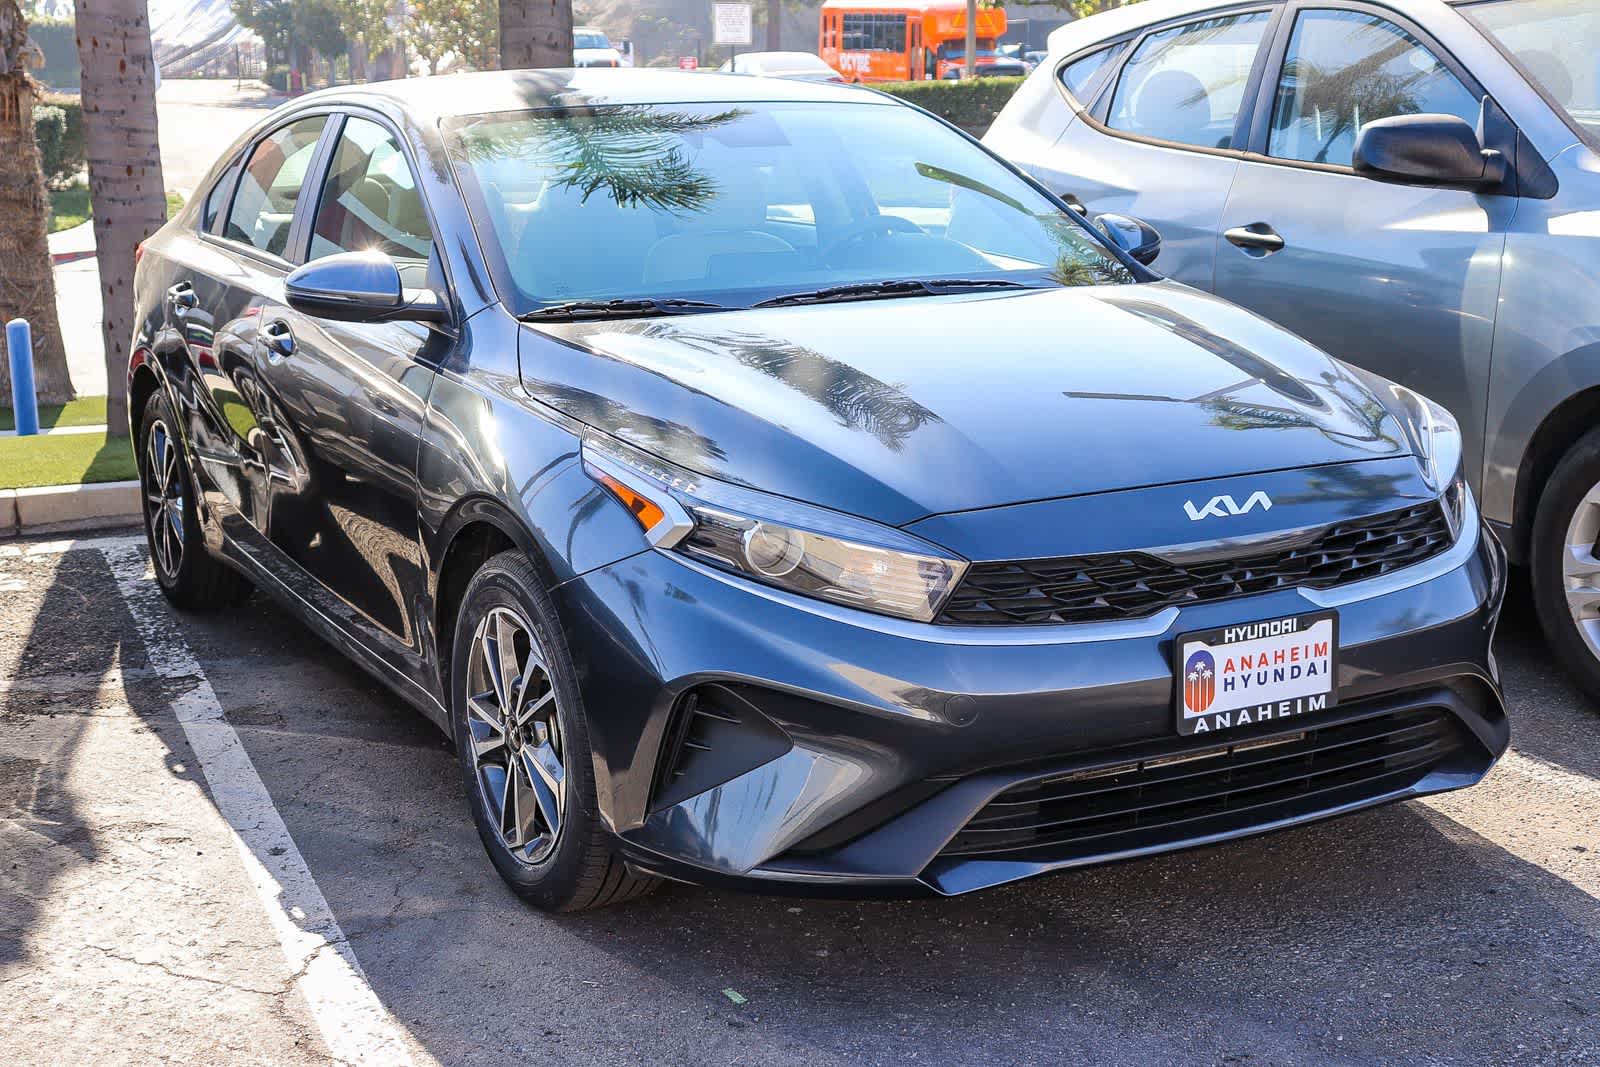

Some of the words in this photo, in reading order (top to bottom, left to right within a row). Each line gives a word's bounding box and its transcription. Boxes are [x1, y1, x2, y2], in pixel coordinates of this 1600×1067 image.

[1224, 618, 1297, 643] HYUNDAI
[1224, 641, 1328, 674] ANAHEIM
[1224, 660, 1327, 692] HYUNDAI
[1193, 695, 1326, 734] ANAHEIM
